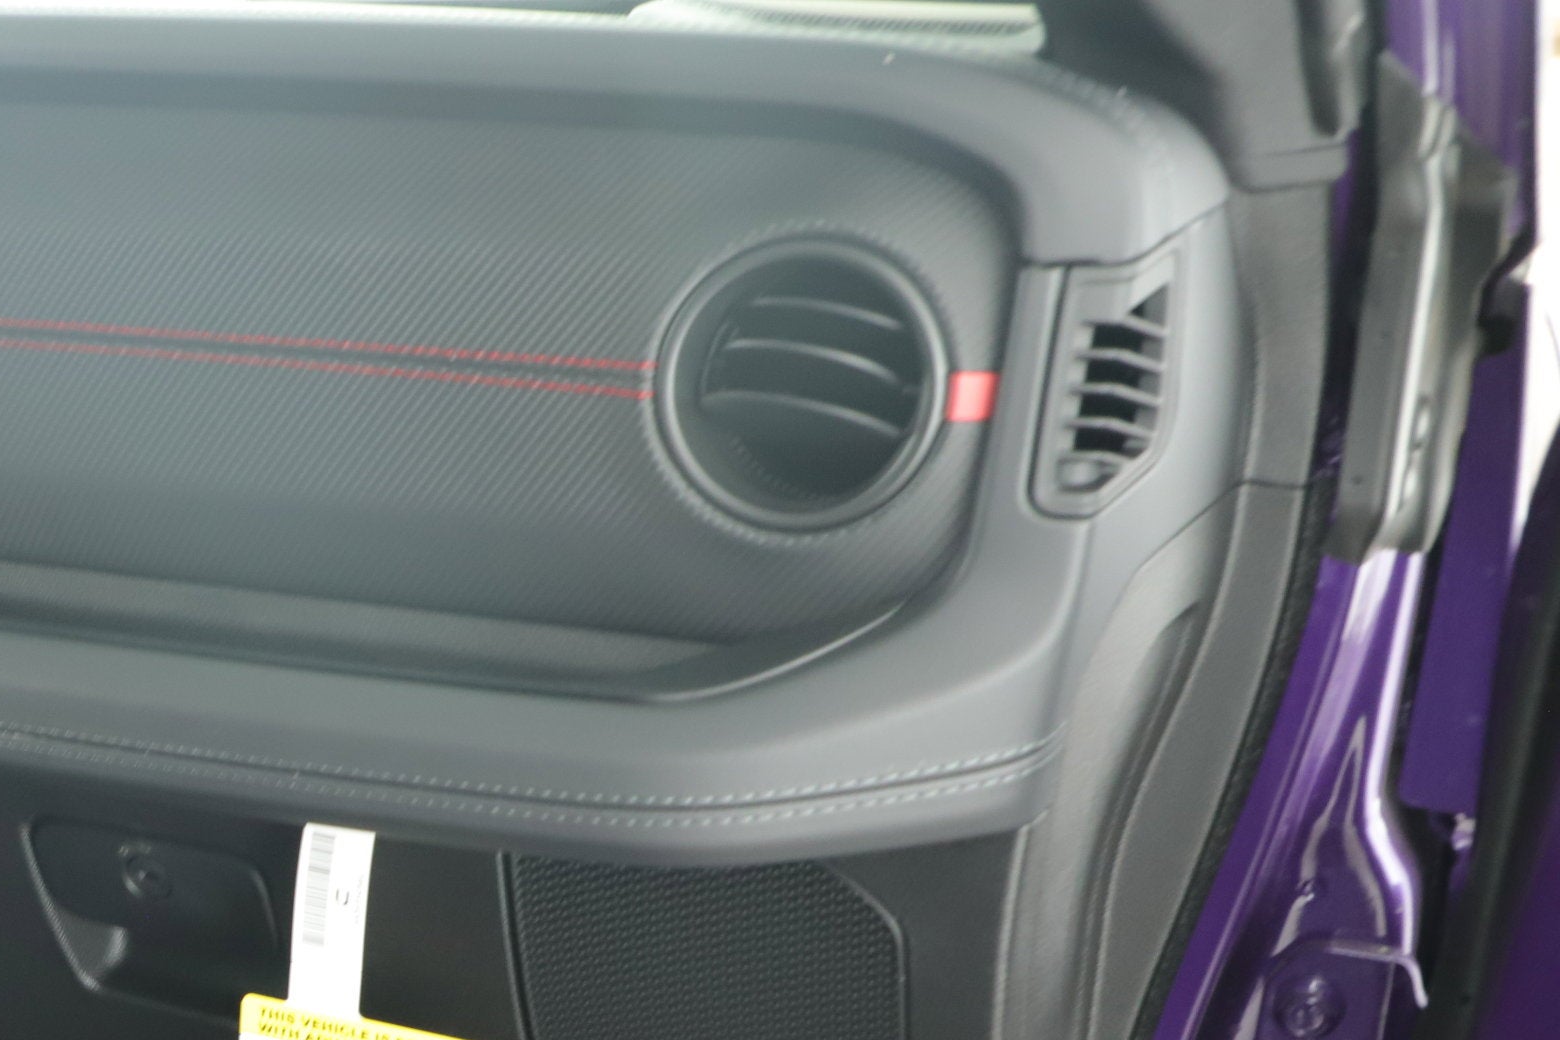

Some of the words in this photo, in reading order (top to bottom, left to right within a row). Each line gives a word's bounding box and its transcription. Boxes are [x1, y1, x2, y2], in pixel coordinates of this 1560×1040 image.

[258, 1023, 299, 1040] WITH
[260, 1007, 295, 1025] THIS
[302, 1016, 368, 1040] VEHICLE
